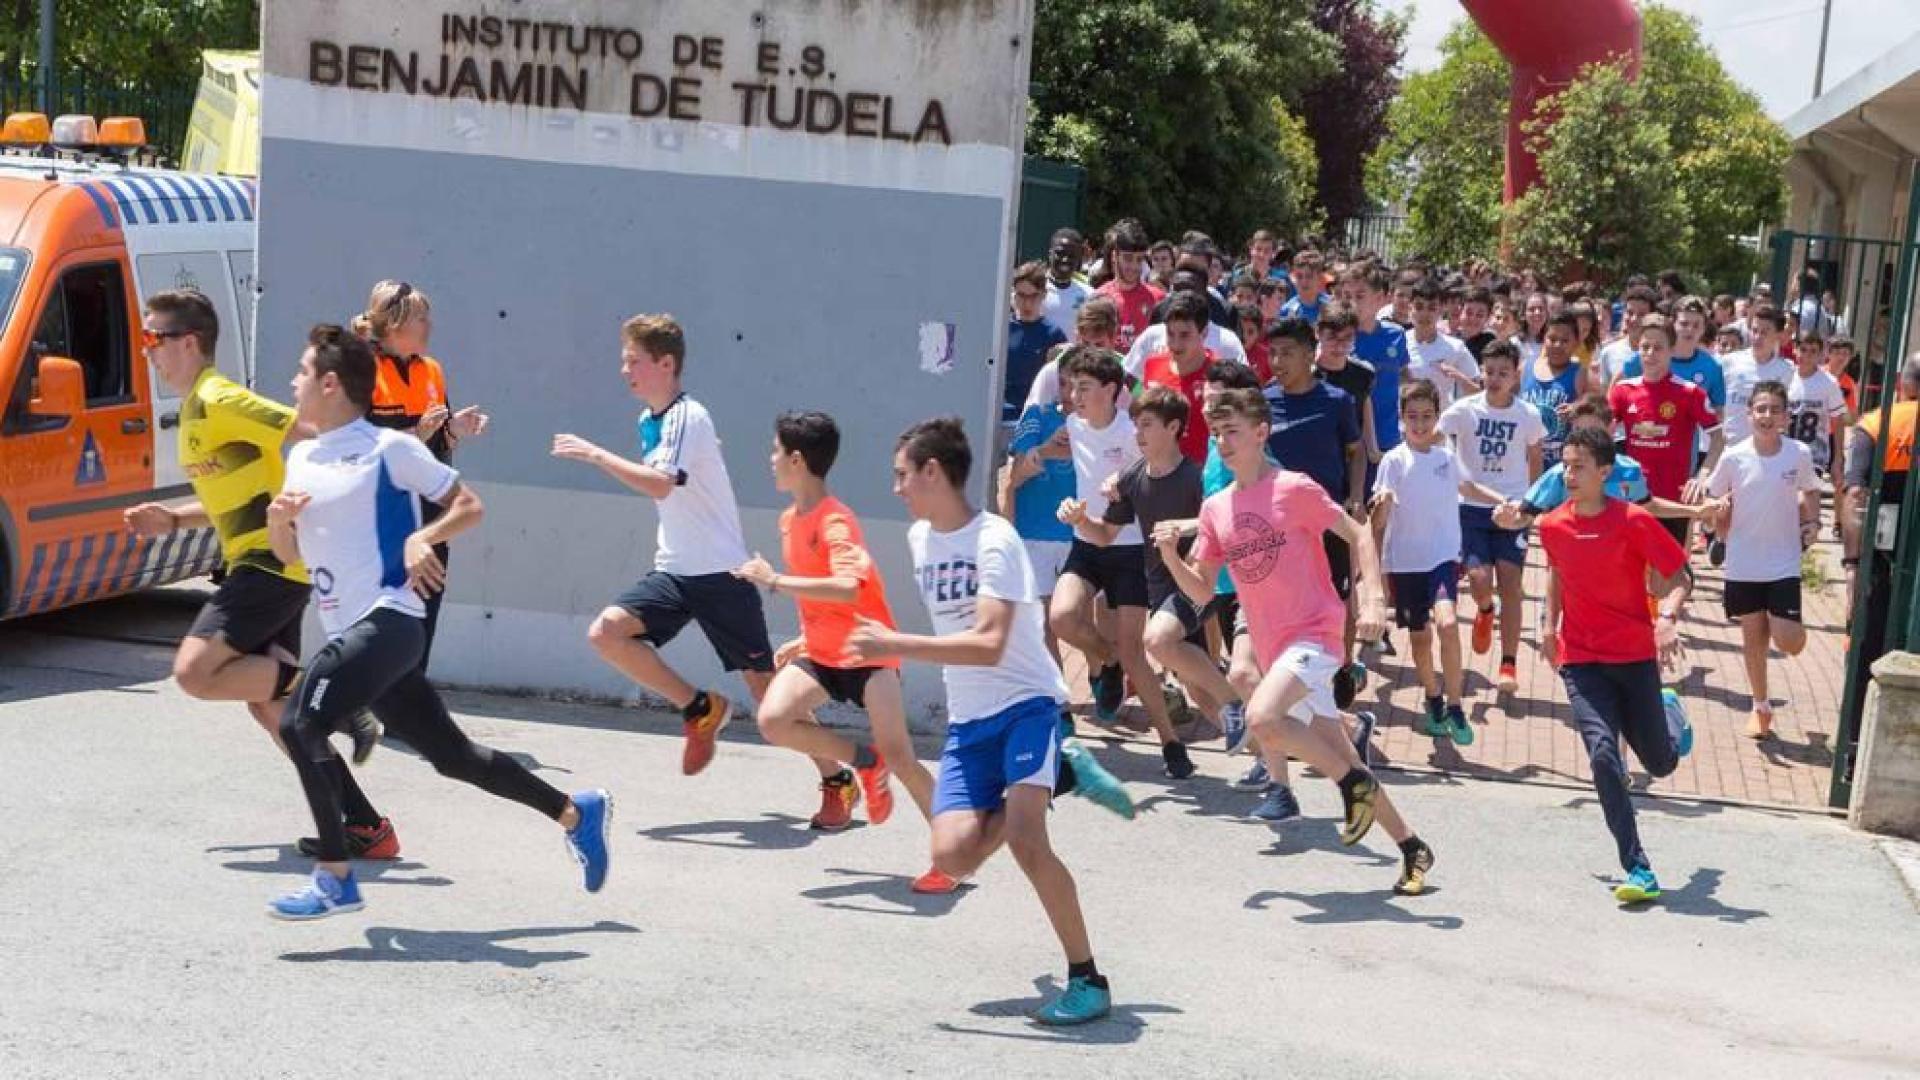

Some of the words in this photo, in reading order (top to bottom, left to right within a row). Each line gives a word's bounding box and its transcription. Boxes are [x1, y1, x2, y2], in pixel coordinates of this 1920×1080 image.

[441, 12, 643, 60] INSTITUTO
[672, 34, 724, 69] DE
[757, 41, 836, 77] E.S.
[309, 41, 588, 111] BENJAMIN
[630, 73, 702, 121] DE
[732, 82, 951, 145] TUDELA
[1475, 418, 1518, 441] JUST
[1479, 439, 1507, 457] DO
